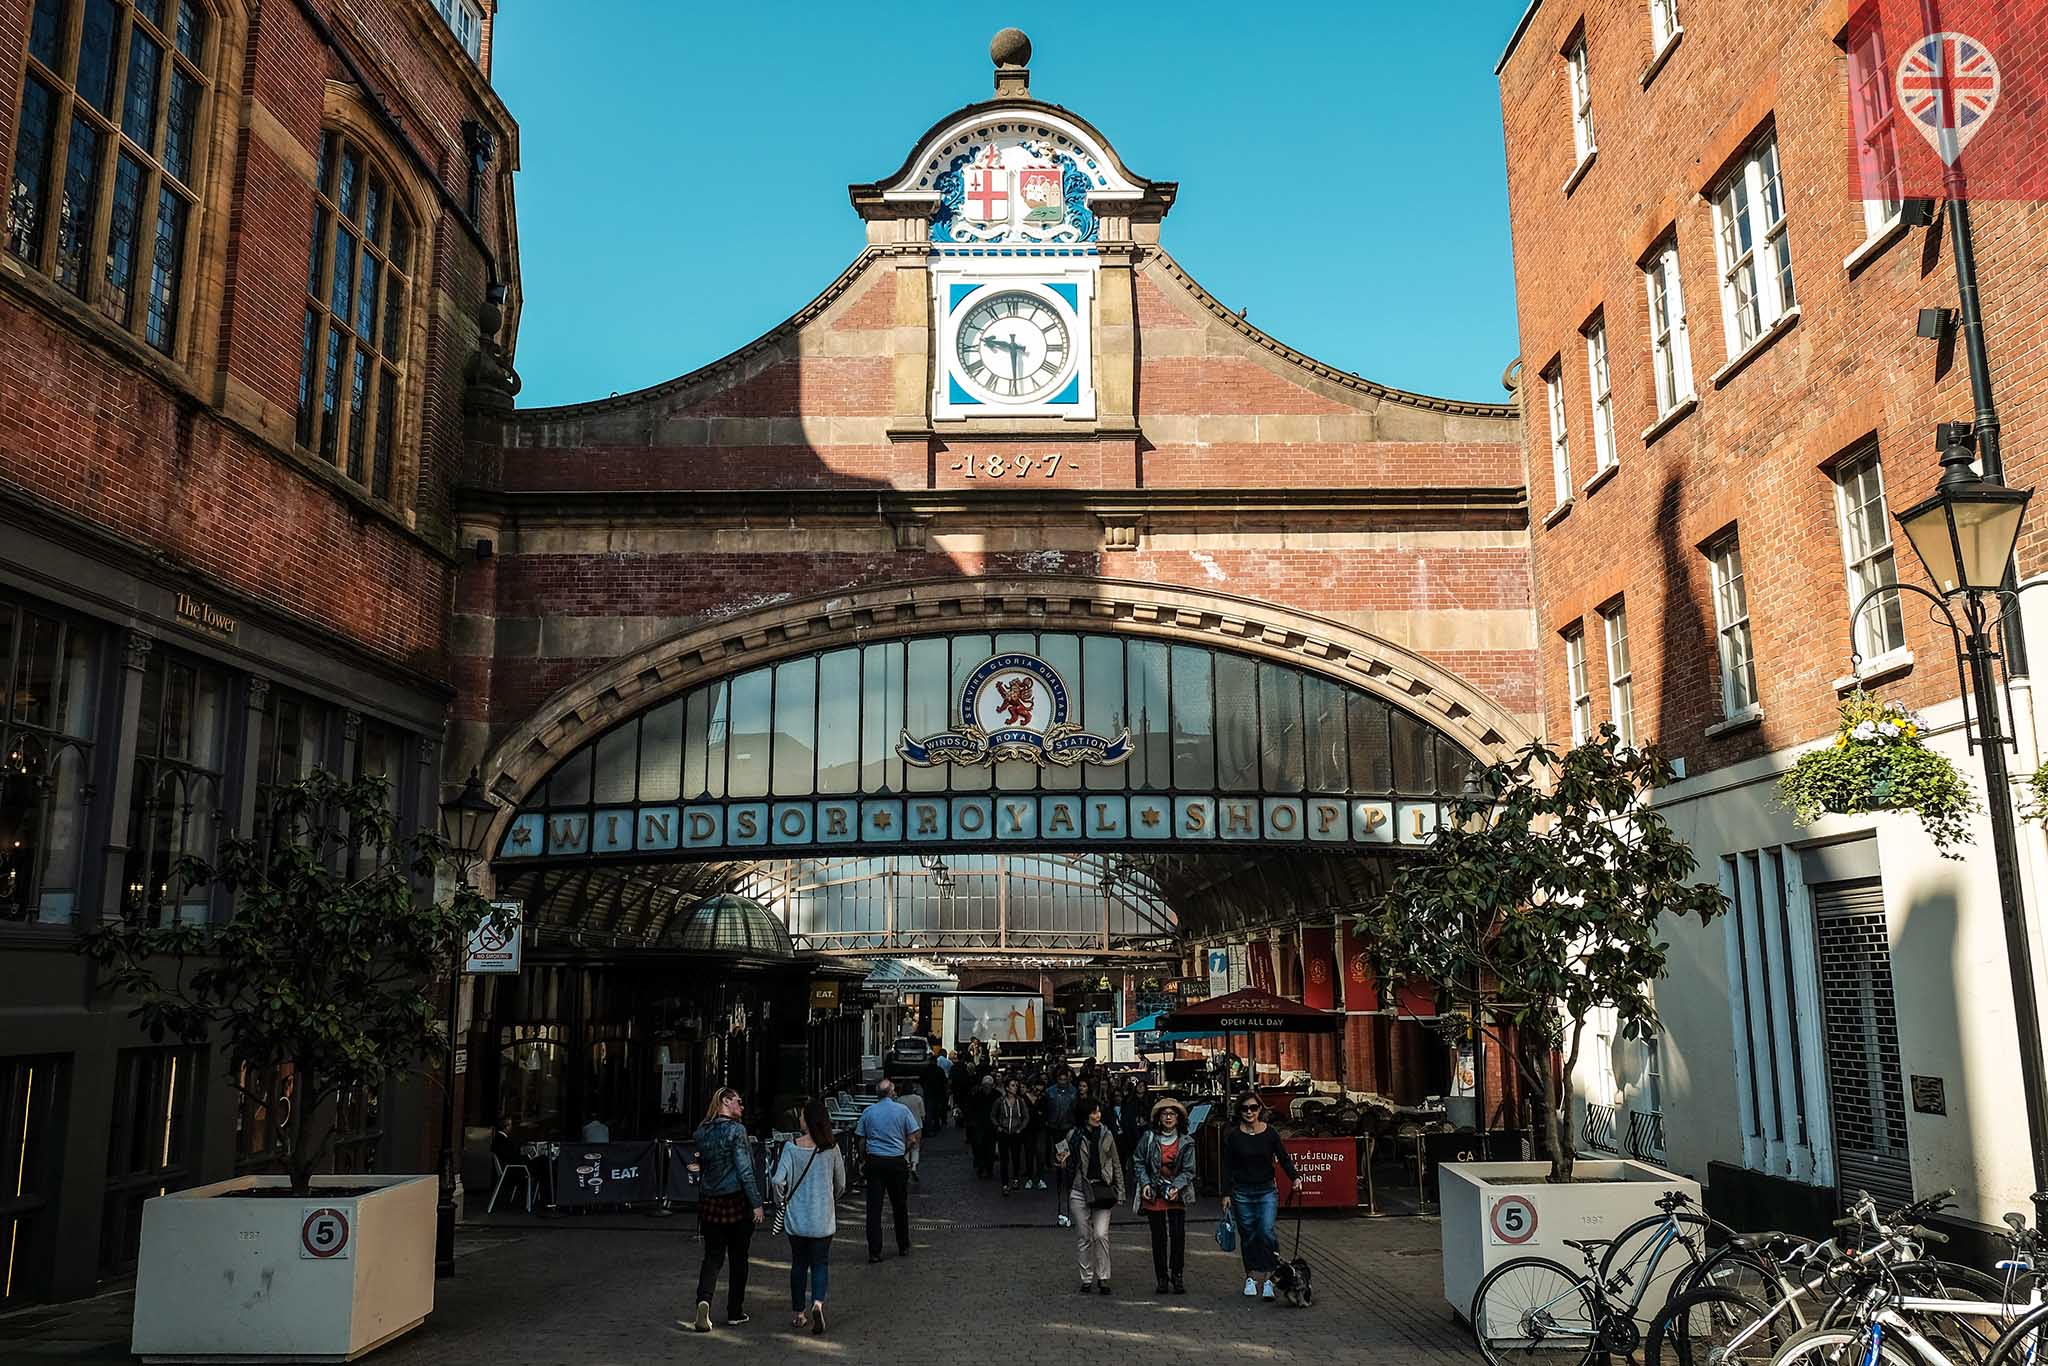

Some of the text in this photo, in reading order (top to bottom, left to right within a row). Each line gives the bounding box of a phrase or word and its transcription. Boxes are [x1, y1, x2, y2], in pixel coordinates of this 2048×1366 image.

[176, 592, 202, 619] The
[202, 602, 238, 632] Tower
[964, 672, 985, 719] SERVIRE
[989, 657, 1033, 671] GLORIA
[926, 732, 1107, 750] WINDSOR ROYAL STATION
[550, 802, 1426, 849] WINDSOR ROYAL SHOPPI
[815, 990, 834, 998] EAT.
[1220, 1018, 1284, 1027] OPEN ALL DAY
[611, 1165, 639, 1180] EAT.
[1293, 1161, 1332, 1172] ÉJEUNER
[1505, 1208, 1523, 1232] 5
[315, 1221, 334, 1245] 5
